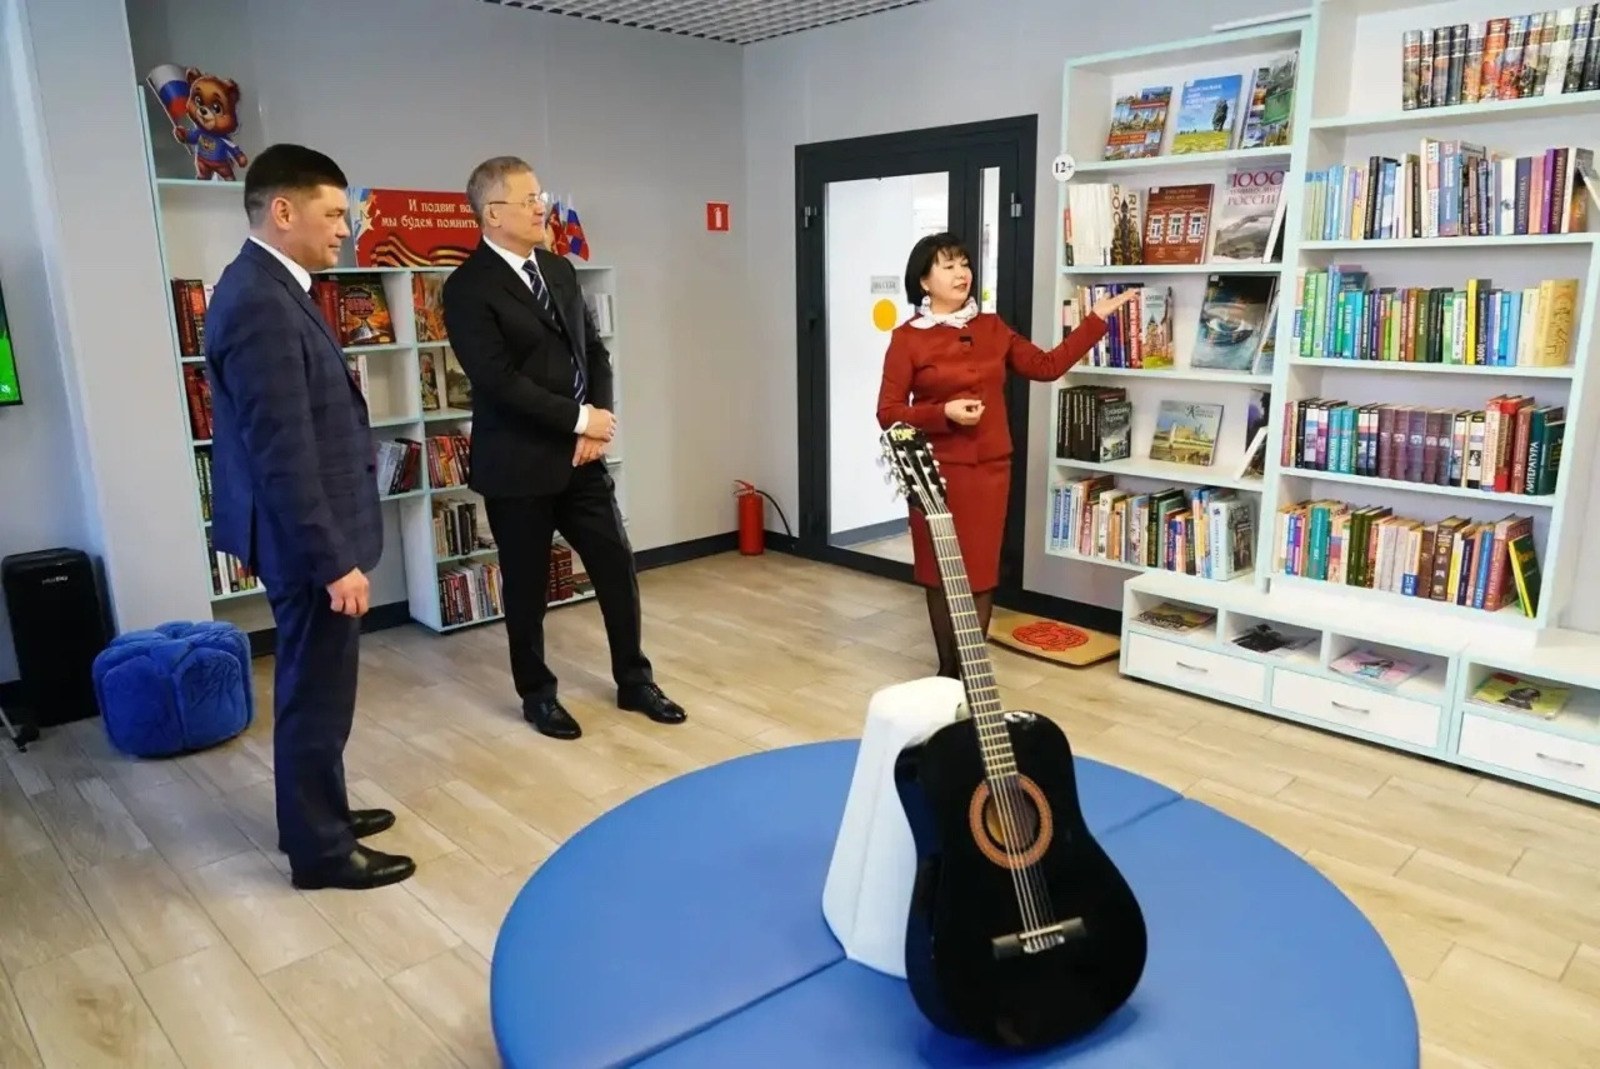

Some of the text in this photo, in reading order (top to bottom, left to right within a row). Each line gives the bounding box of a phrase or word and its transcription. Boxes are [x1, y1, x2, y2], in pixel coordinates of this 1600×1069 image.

[1055, 161, 1074, 174] 12+
[408, 199, 474, 213] И подвиг ва
[381, 214, 479, 230] мы будем помнить
[1526, 441, 1539, 493] ЛИТЕРАТУРА
